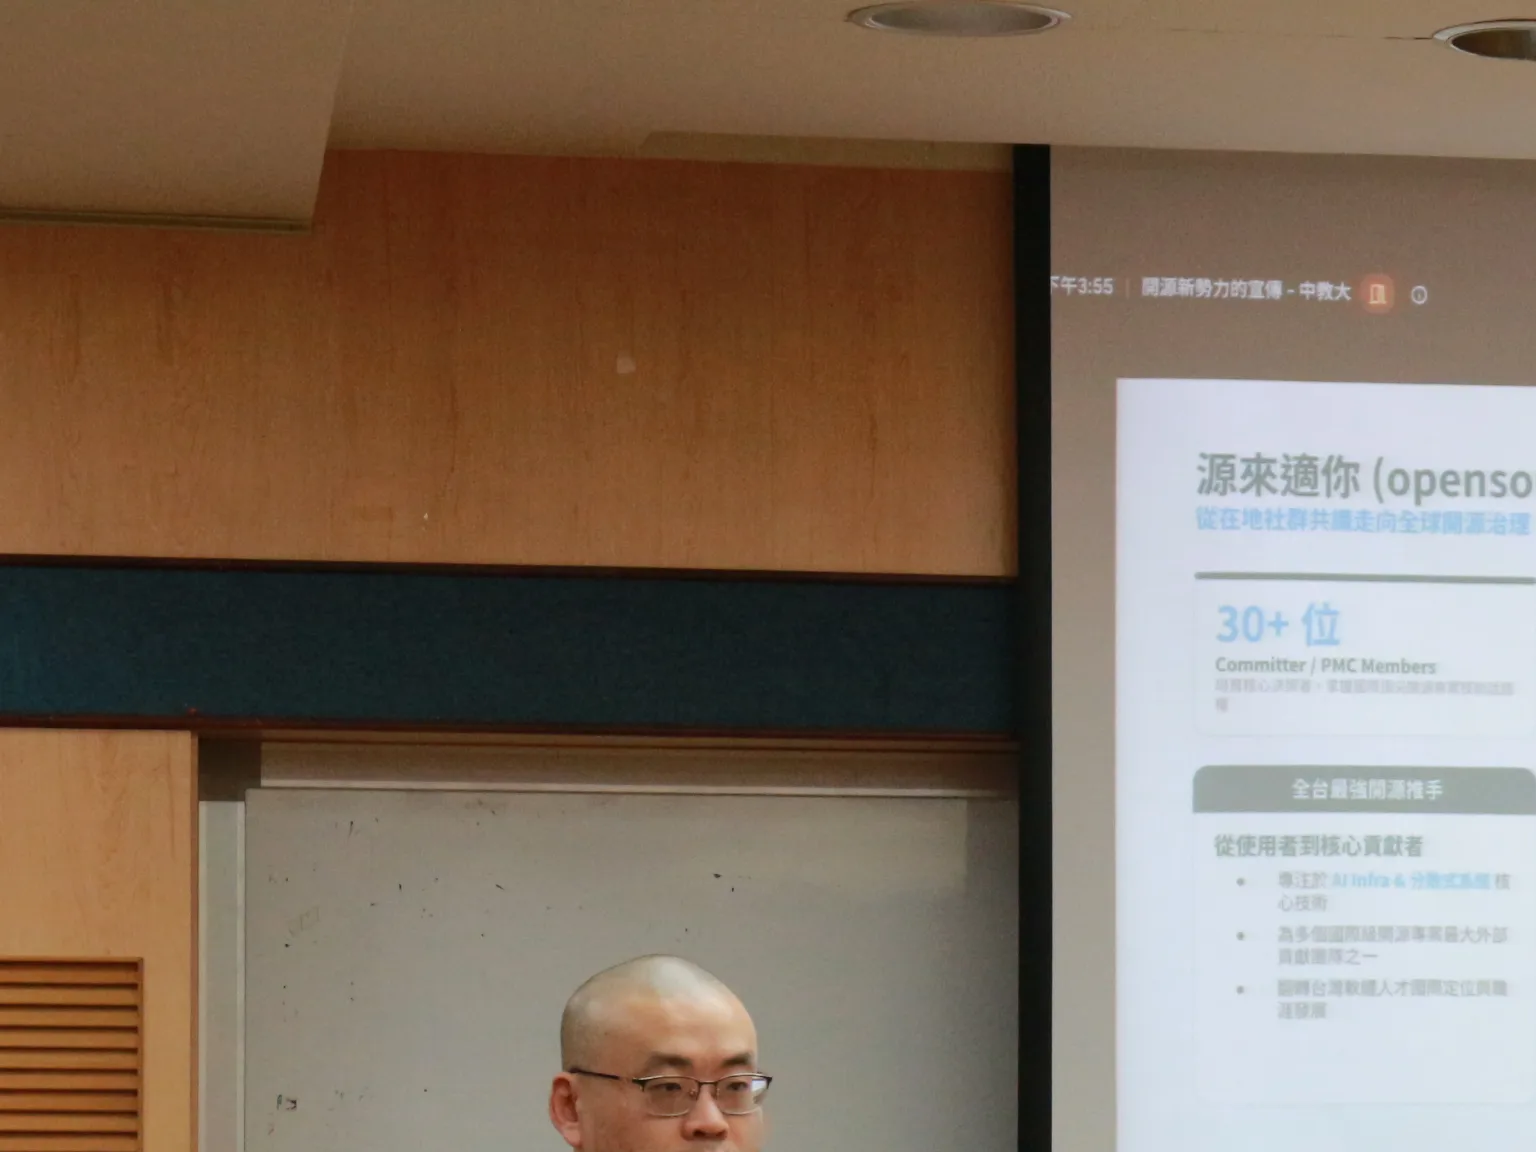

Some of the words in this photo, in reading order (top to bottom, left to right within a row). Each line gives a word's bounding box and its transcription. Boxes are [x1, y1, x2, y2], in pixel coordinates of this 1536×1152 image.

[1141, 276, 1283, 300] 開源新勢力的宣傳
[1299, 281, 1352, 301] 中教大
[1196, 452, 1360, 498] 源來適你
[1216, 604, 1290, 644] 30+
[1301, 601, 1342, 647] 位
[1215, 656, 1307, 674] Committer
[1321, 657, 1357, 674] PMC
[1361, 658, 1437, 675] Members
[1291, 778, 1444, 801] 全台最強開源推手
[1214, 834, 1424, 858] 從使用者到核心貢獻者
[1278, 894, 1328, 912] 心技術
